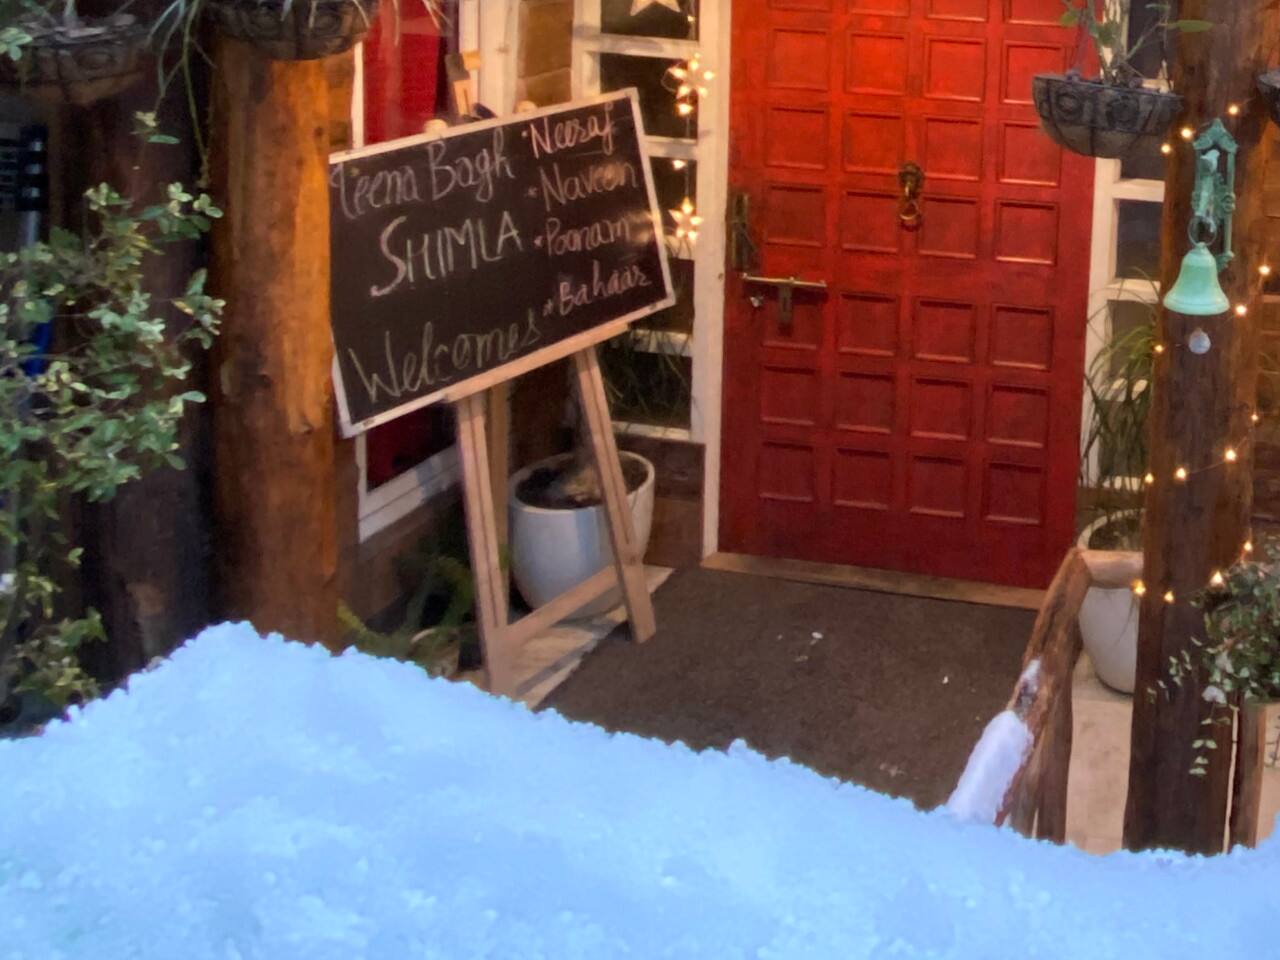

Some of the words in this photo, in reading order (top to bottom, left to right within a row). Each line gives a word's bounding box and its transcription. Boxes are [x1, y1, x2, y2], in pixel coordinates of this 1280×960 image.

[539, 161, 638, 211] Naveen
[369, 210, 524, 297] SHIMLA
[544, 216, 632, 257] Poonam
[348, 308, 542, 403] Welcomes
